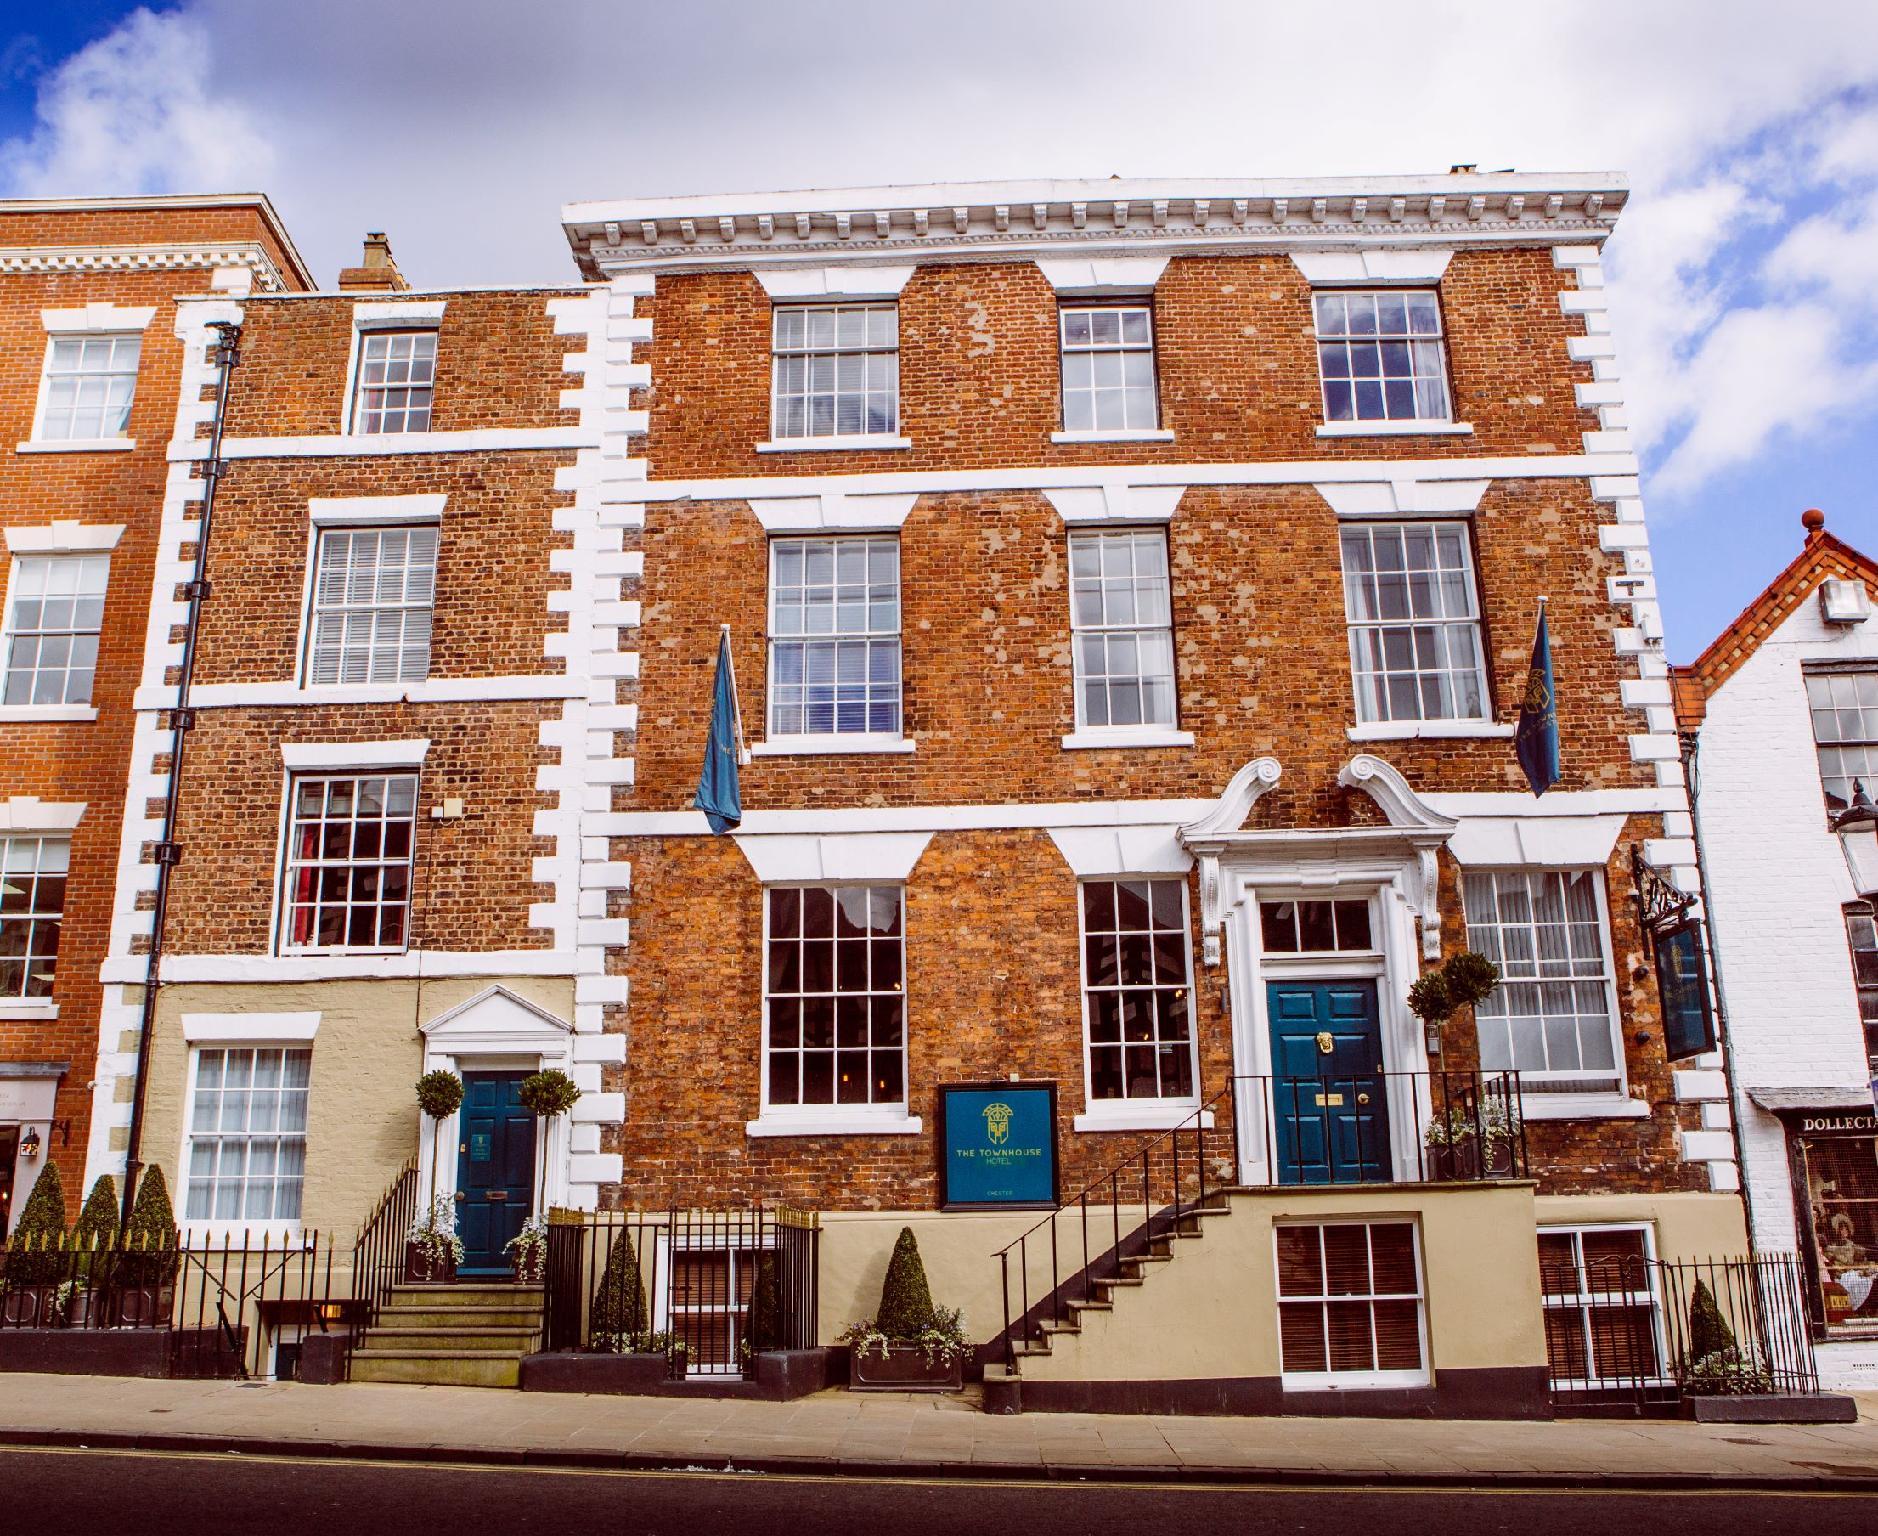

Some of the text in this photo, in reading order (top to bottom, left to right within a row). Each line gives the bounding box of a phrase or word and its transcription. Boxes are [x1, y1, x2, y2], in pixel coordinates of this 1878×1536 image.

[956, 1149, 1041, 1157] THE TOWNHOUSE
[986, 1157, 1012, 1165] HOTEL
